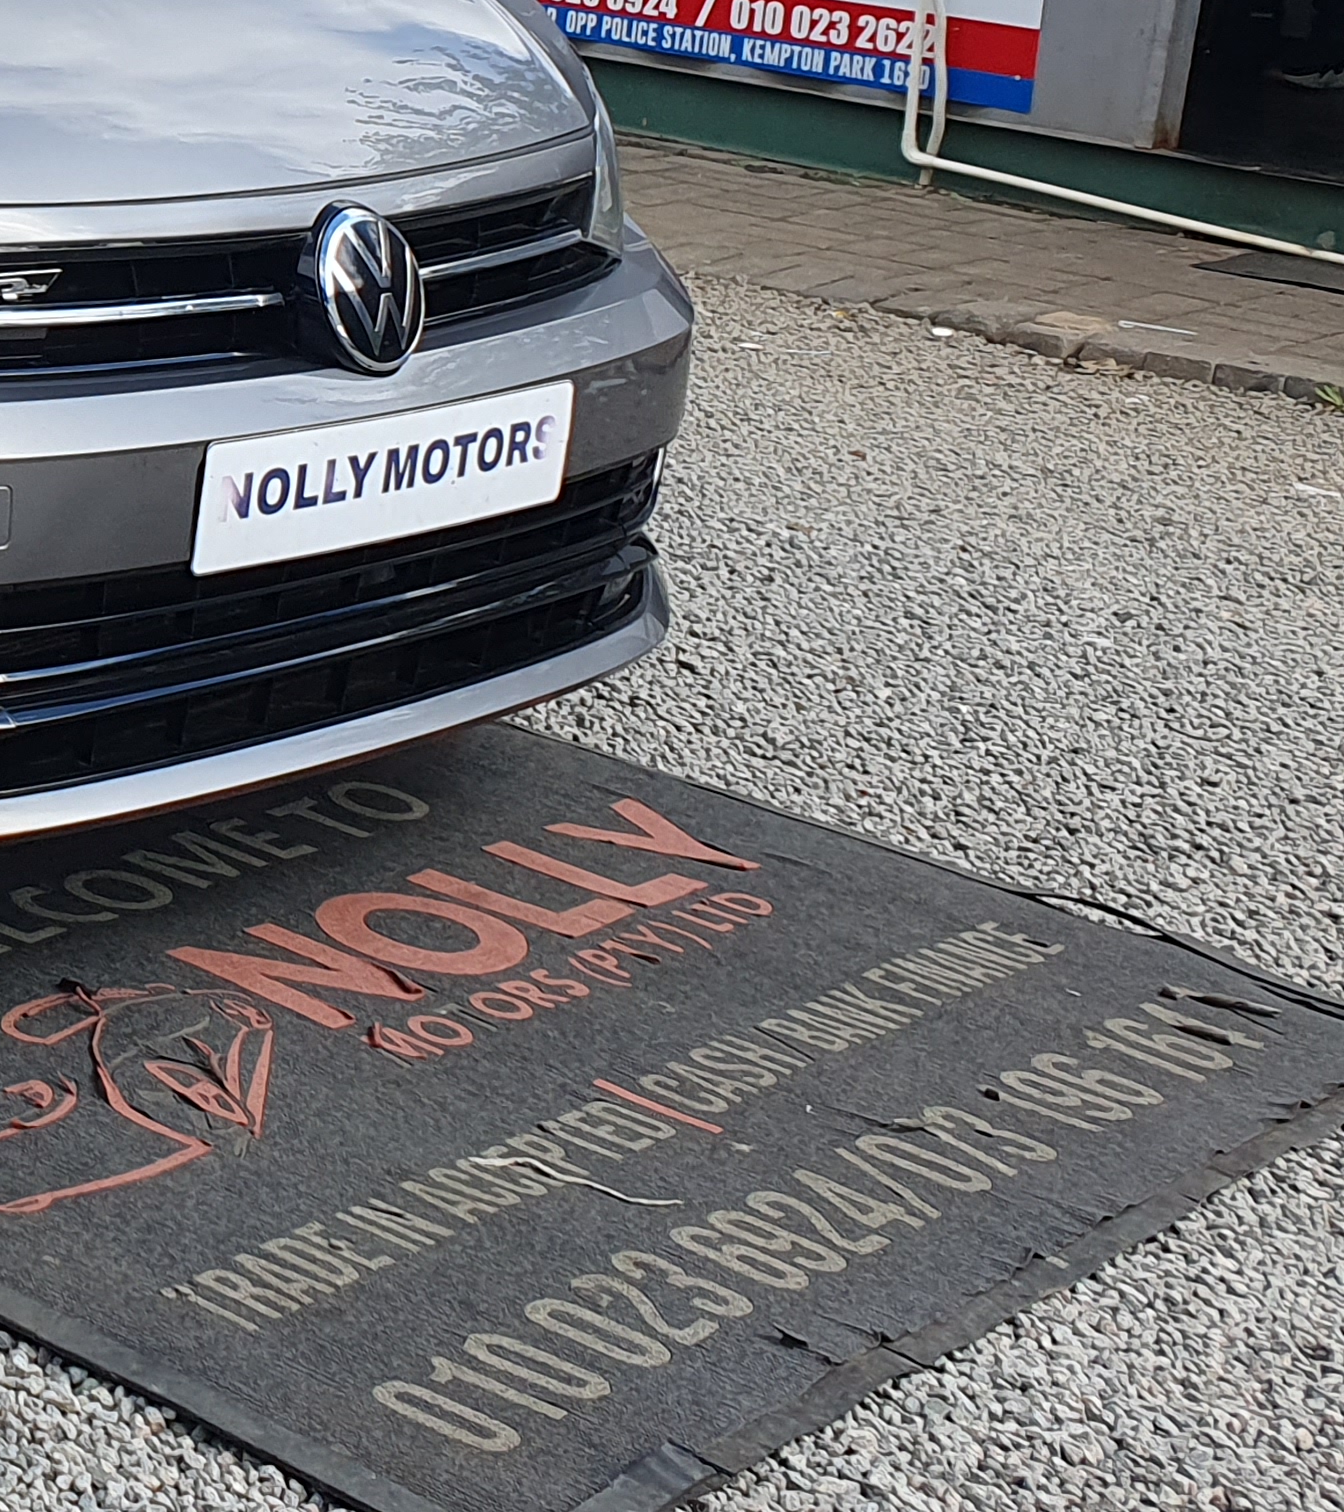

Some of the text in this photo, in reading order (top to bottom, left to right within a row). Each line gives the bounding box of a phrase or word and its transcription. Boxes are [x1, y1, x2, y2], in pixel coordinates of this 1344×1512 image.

[565, 9, 597, 37] OPP
[601, 15, 659, 48] POLICE
[661, 24, 737, 63] STATION,
[741, 37, 824, 73] KEMPTON
[828, 49, 877, 81] PARK
[879, 59, 931, 91] 160
[790, 4, 850, 45] 023
[219, 414, 557, 524] NOLLY MOTORS
[265, 781, 430, 838] TO
[165, 797, 762, 1028] NOLLY
[360, 892, 774, 1065] MOTORS (PTY) LTD
[161, 1220, 397, 1332] TRADE
[335, 1197, 458, 1253] IN
[861, 920, 1066, 1006] FINANCE
[372, 1332, 611, 1453] 010
[524, 1250, 755, 1368] 023
[980, 1052, 1164, 1133] 196
